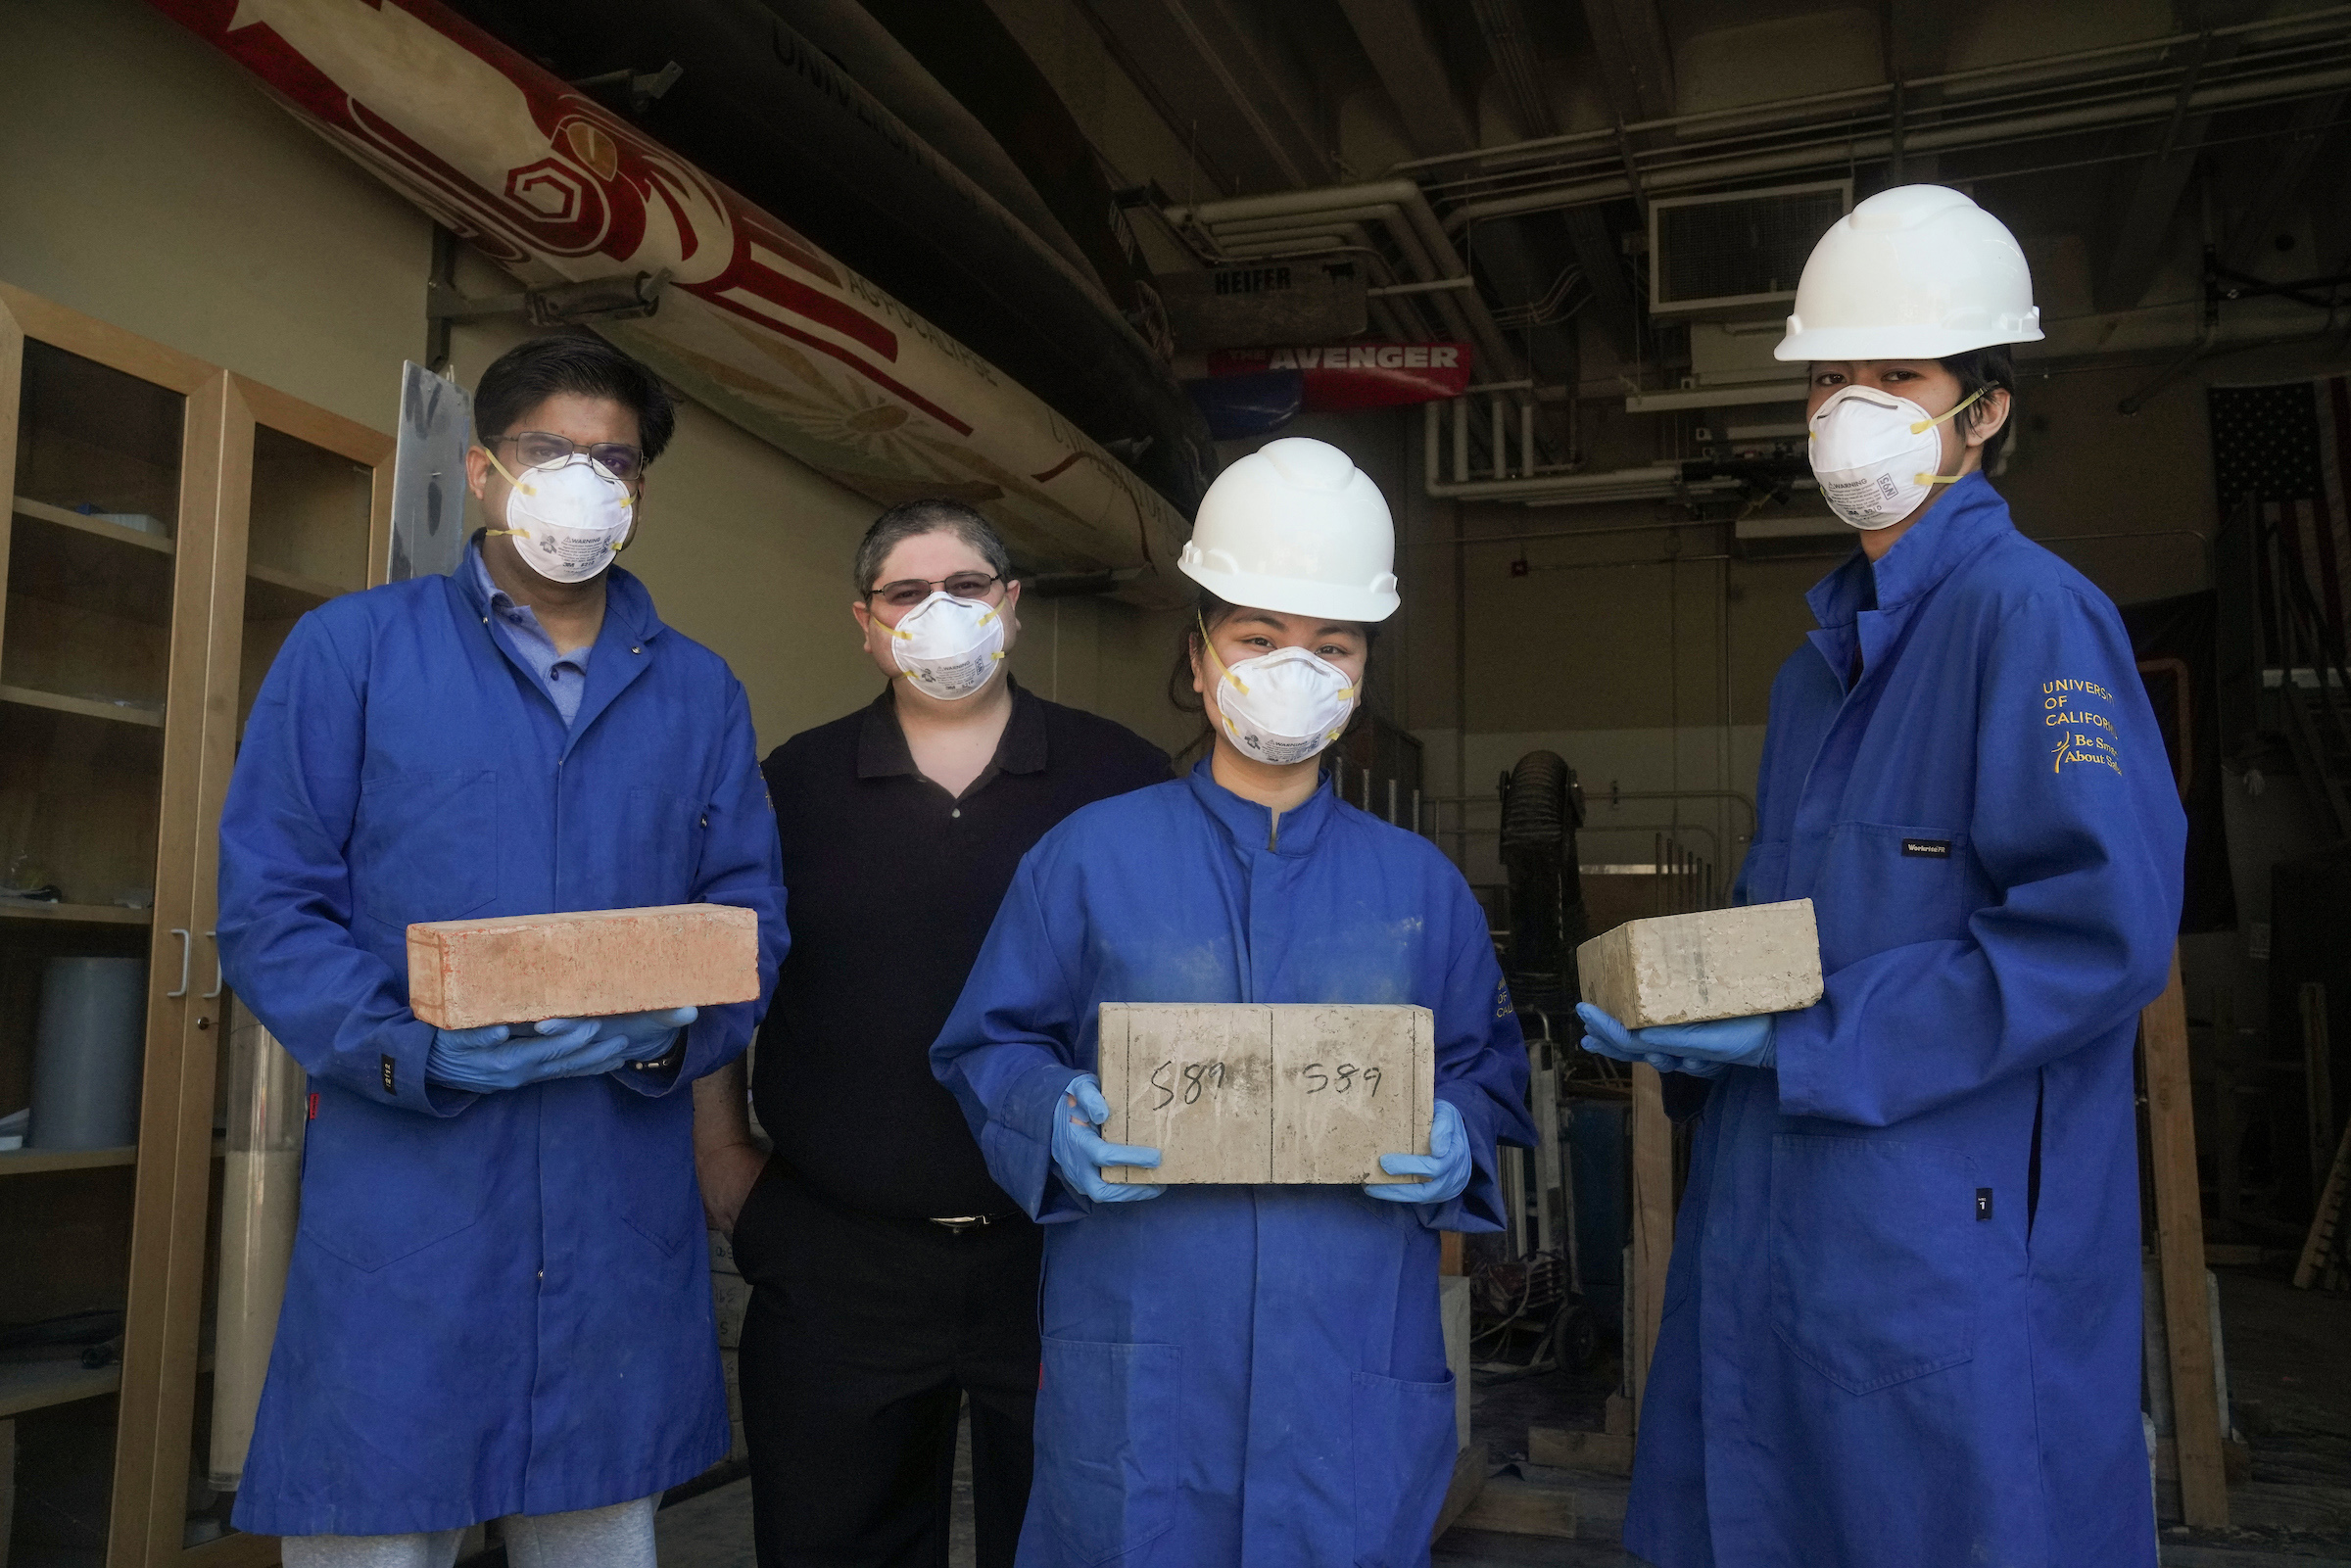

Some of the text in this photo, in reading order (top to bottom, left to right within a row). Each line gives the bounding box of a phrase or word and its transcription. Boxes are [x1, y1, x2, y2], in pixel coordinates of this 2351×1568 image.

[1214, 267, 1291, 295] HEIFER
[1269, 346, 1460, 370] AVENGER
[1834, 478, 1868, 489] WARNING
[1880, 476, 1896, 498] N95
[942, 660, 971, 671] WARNING
[2044, 695, 2067, 710] OF
[2074, 734, 2094, 747] Be
[2064, 750, 2105, 764] About
